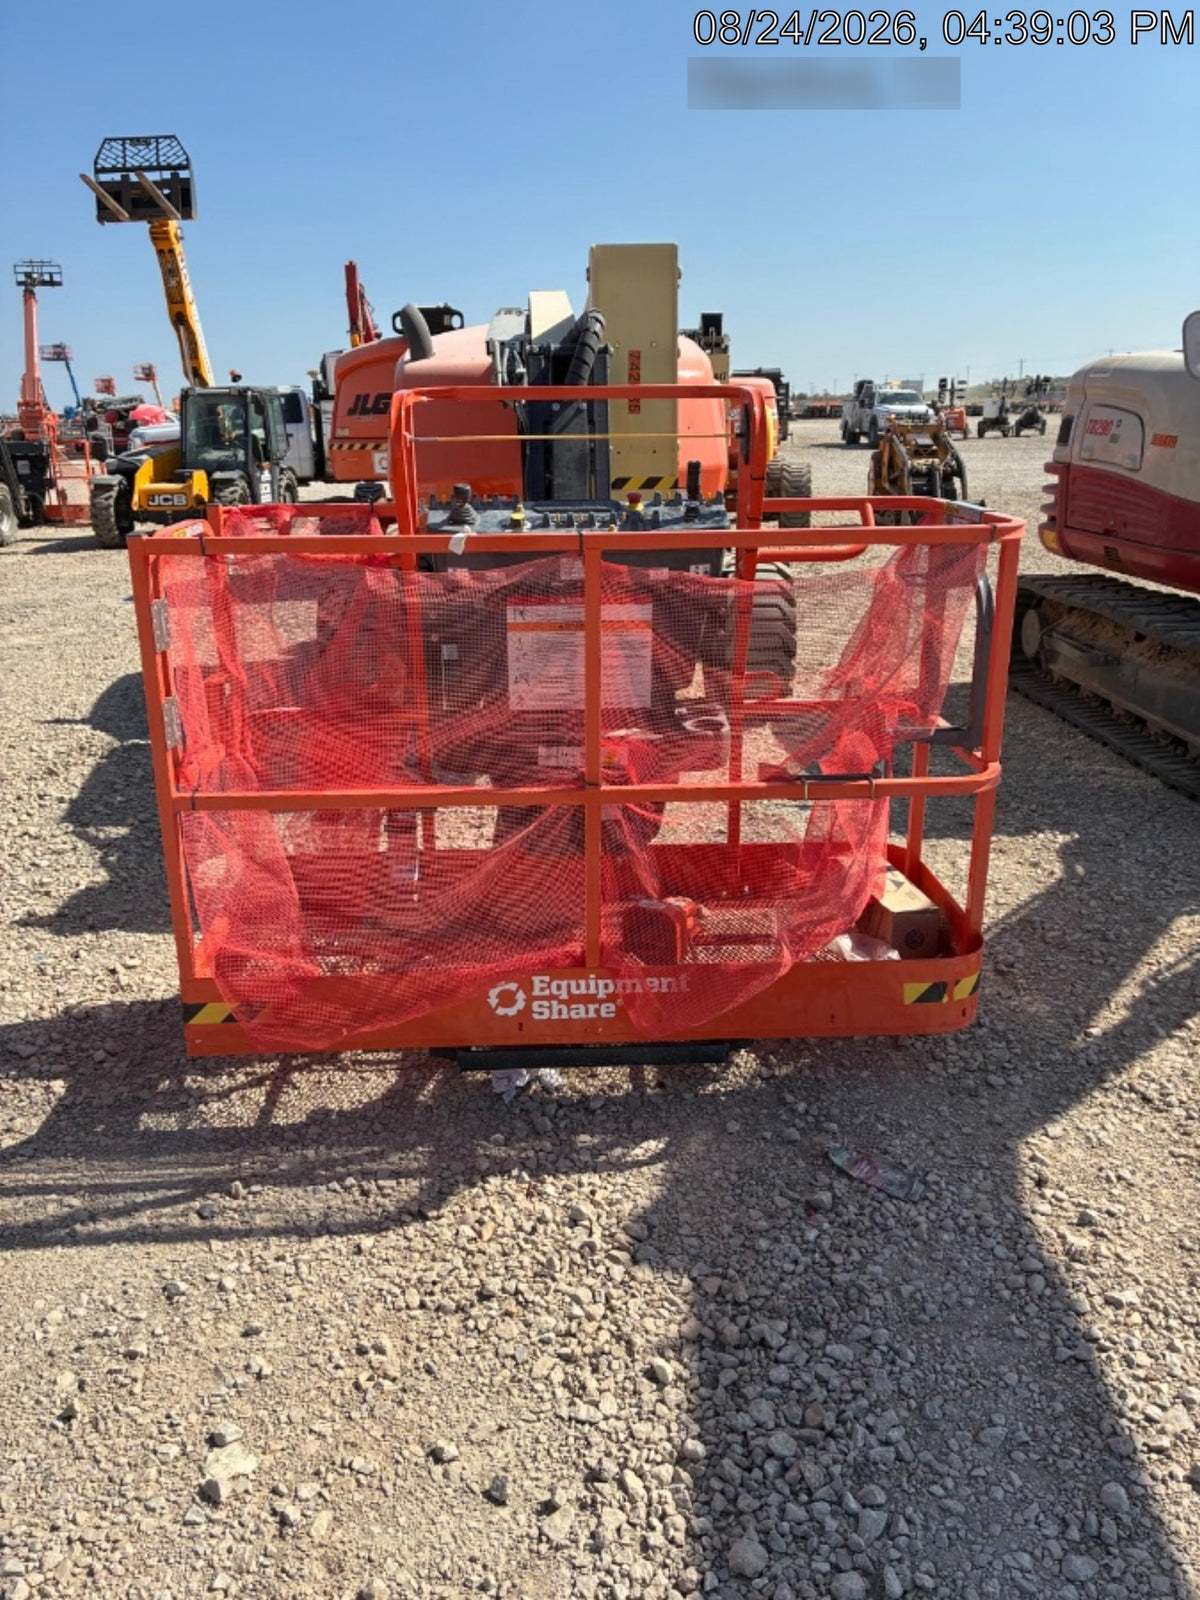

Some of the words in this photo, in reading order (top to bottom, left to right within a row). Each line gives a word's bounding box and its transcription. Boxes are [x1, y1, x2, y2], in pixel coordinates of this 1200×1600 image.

[347, 393, 393, 416] JLG
[148, 494, 187, 506] JCB
[531, 974, 690, 999] Equipment
[531, 1000, 616, 1020] Share
